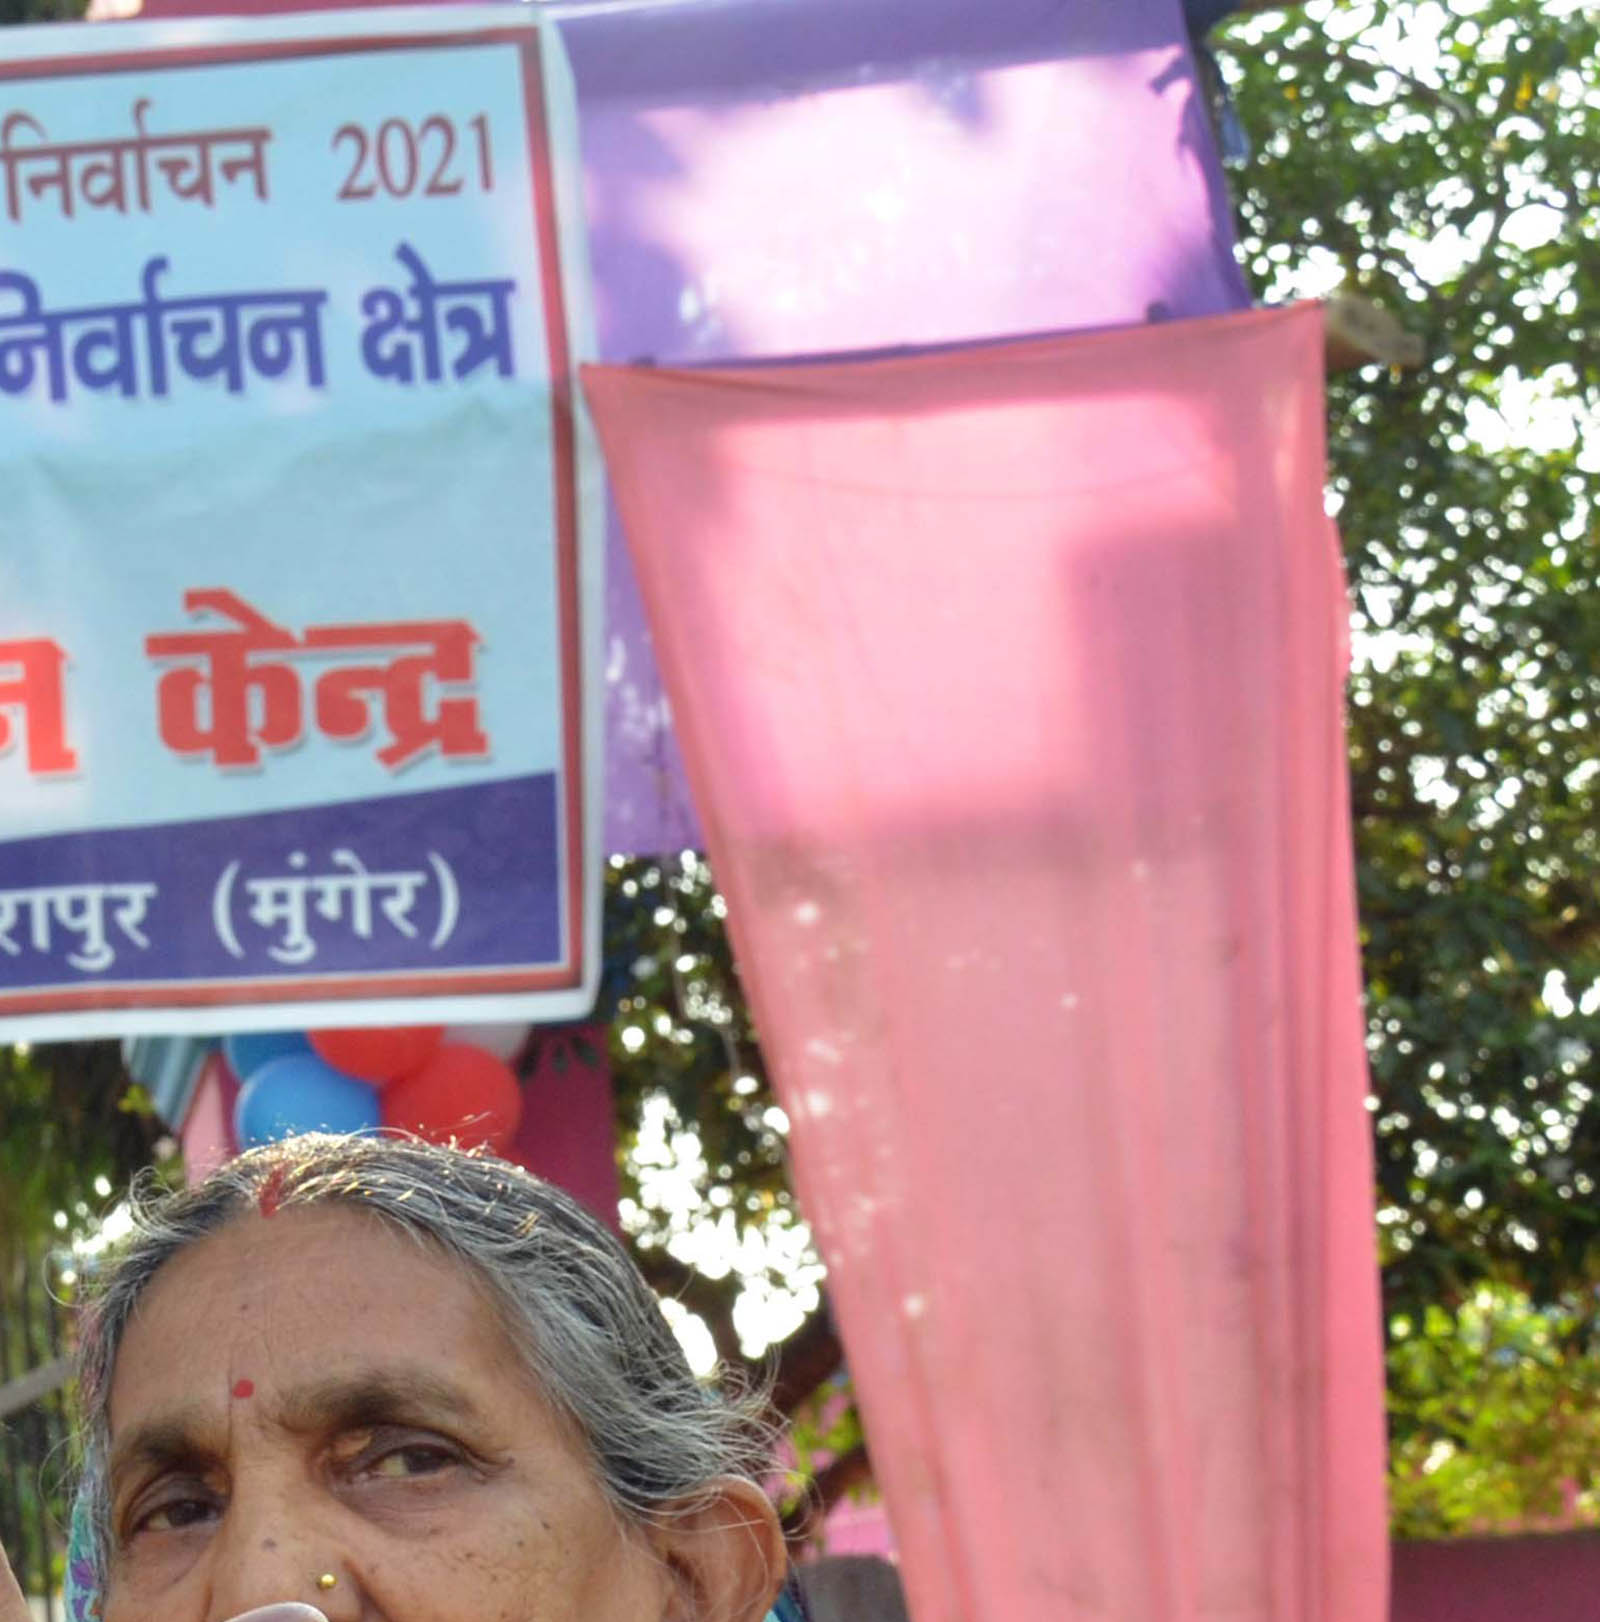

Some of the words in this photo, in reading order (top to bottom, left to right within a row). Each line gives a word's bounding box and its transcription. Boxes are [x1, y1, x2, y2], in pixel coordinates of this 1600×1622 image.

[332, 112, 496, 202] 2021
[360, 240, 516, 386] क्षेत्र
[145, 587, 489, 771] केन्द्र
[213, 849, 461, 963] (मुंगेर)
